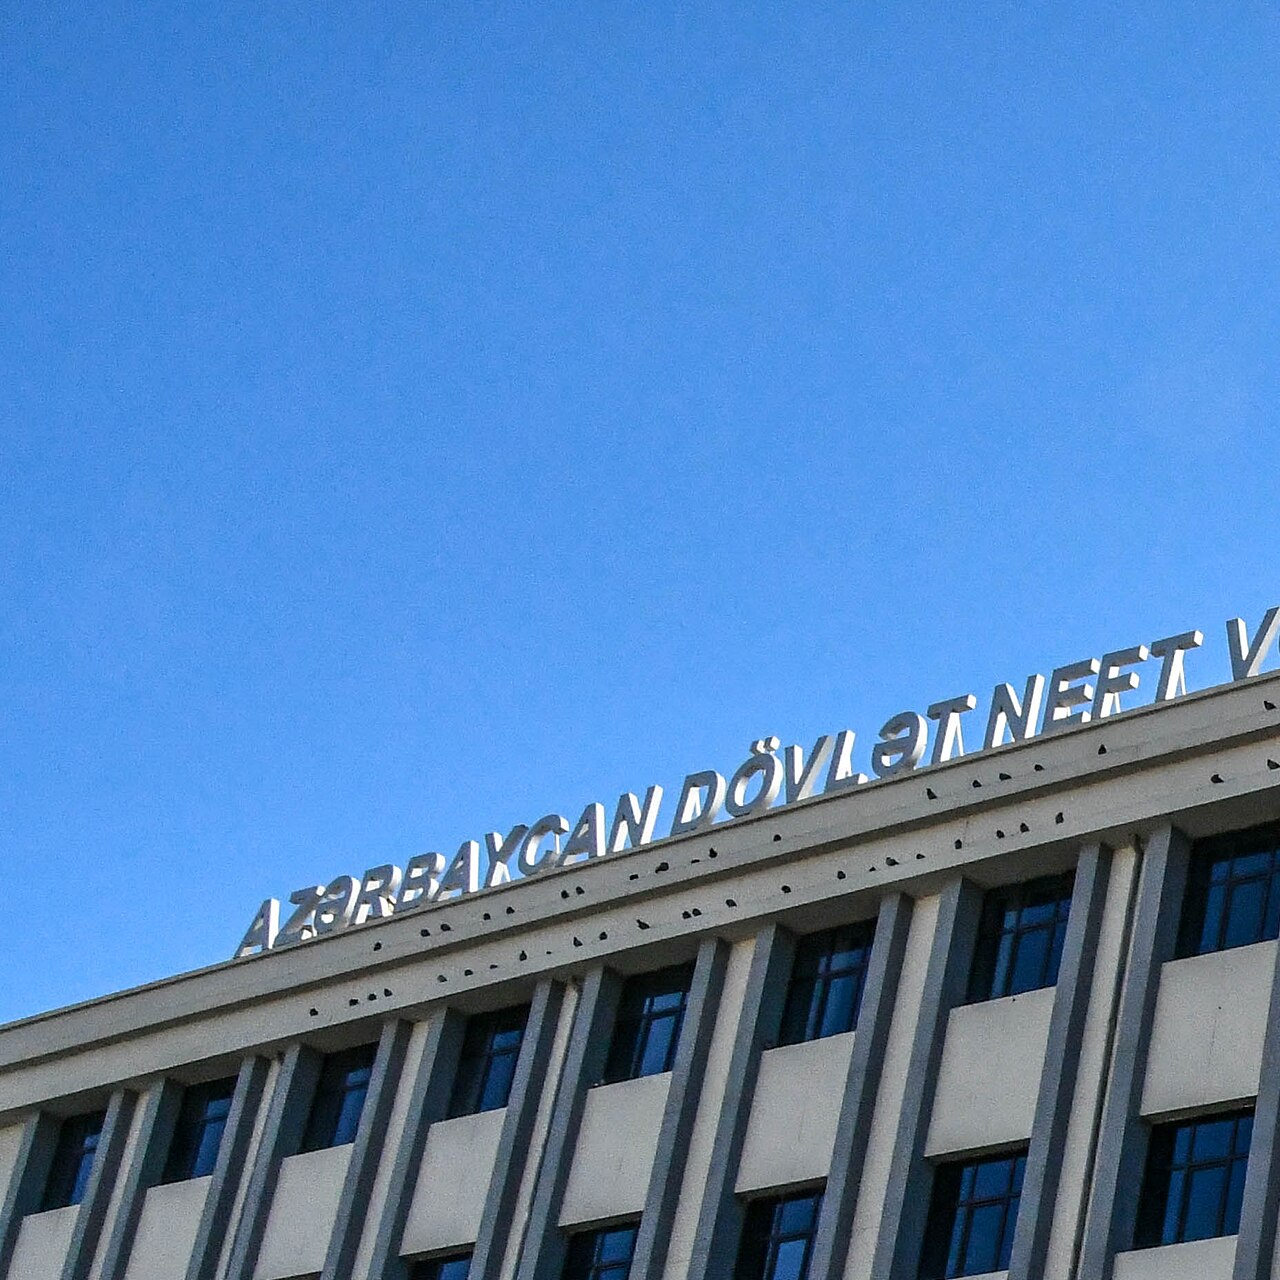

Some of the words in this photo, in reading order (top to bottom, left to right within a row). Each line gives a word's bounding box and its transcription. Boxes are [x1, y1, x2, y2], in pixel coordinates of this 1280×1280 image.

[232, 785, 663, 959] AZƏRBAYCAN
[670, 693, 977, 836] DÖVLƏT
[985, 629, 1203, 751] NEFT
